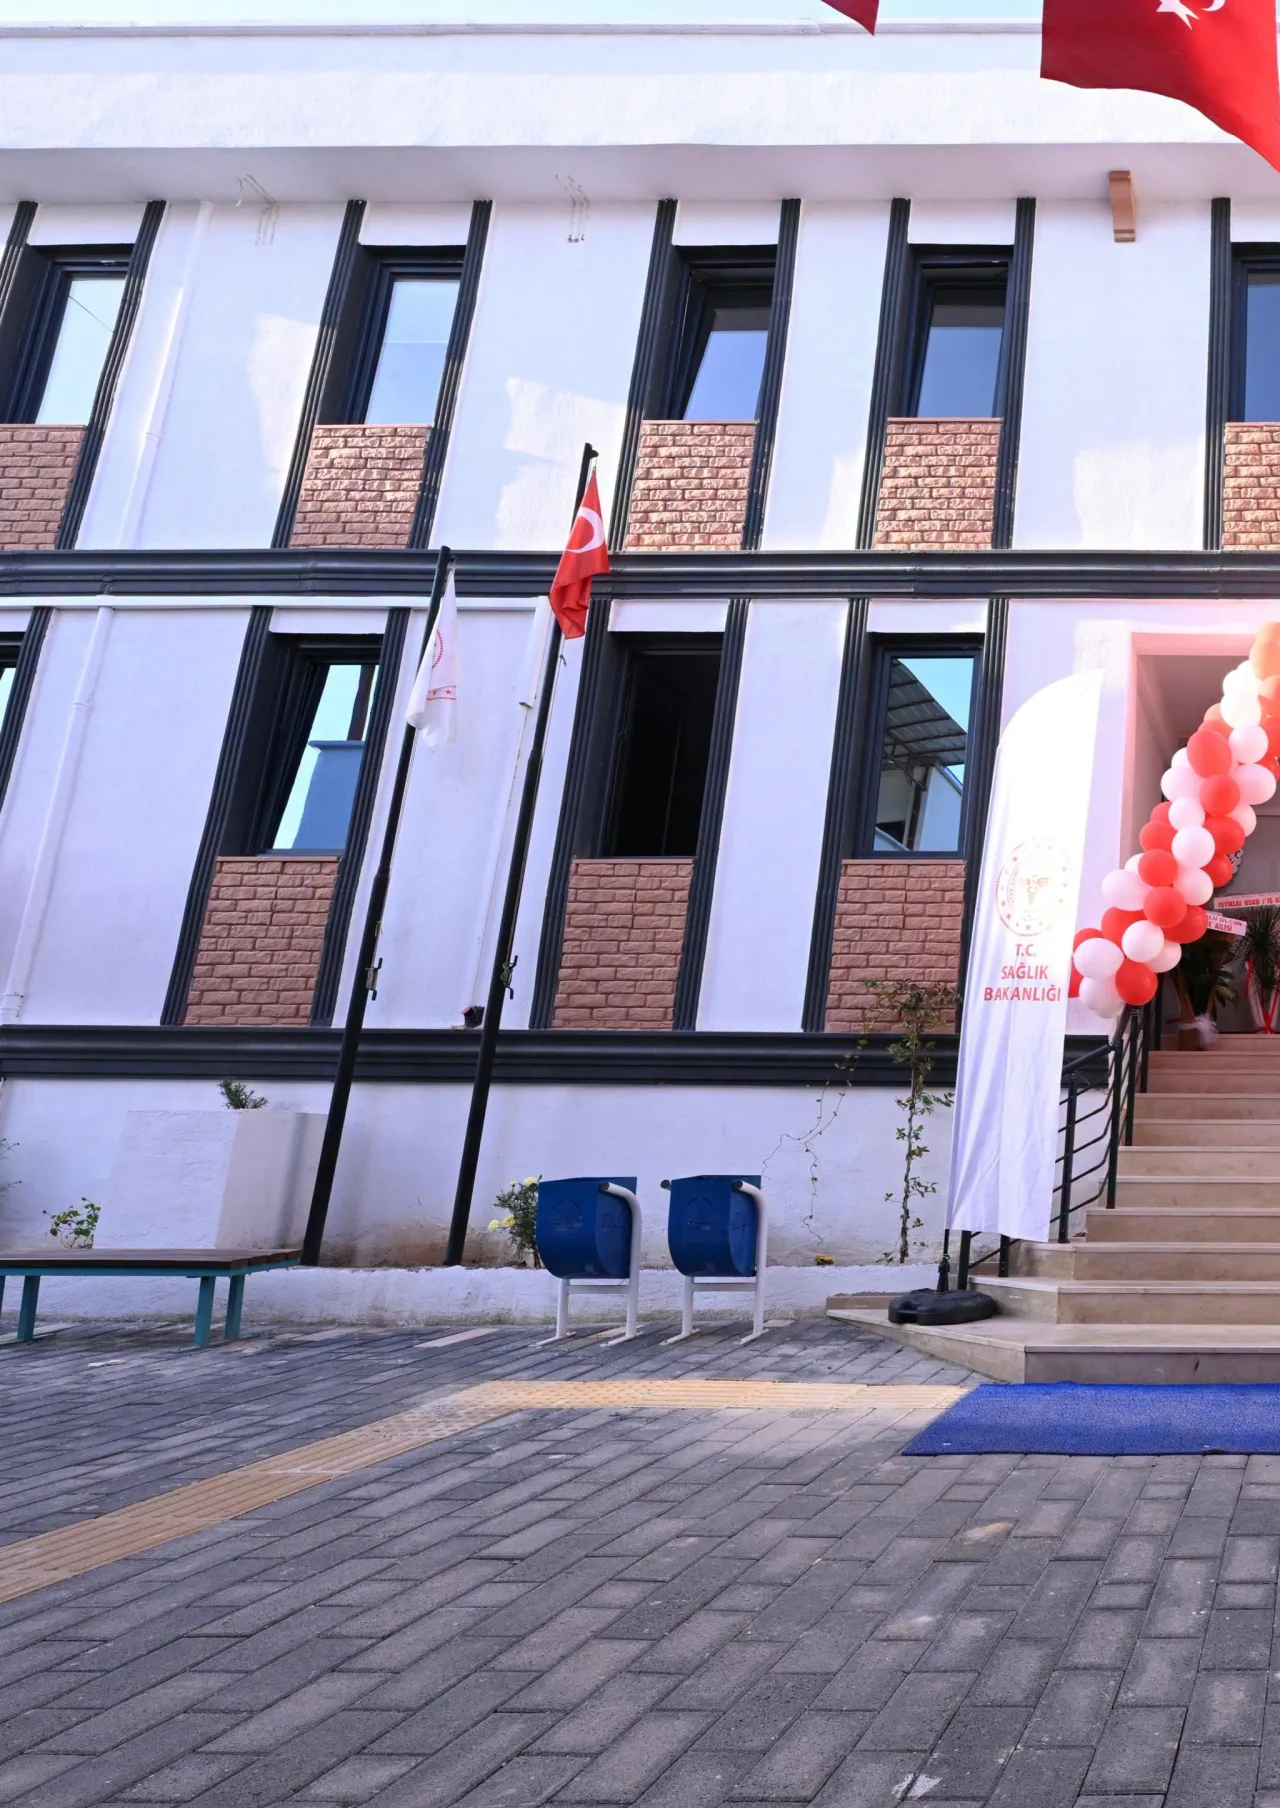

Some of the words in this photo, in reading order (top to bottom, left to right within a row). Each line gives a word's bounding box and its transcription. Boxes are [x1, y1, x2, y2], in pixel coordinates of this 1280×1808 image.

[1014, 943, 1037, 957] T.C.
[1001, 962, 1049, 980] SAĞLIK
[983, 984, 1062, 1002] BAKANLIĞI
